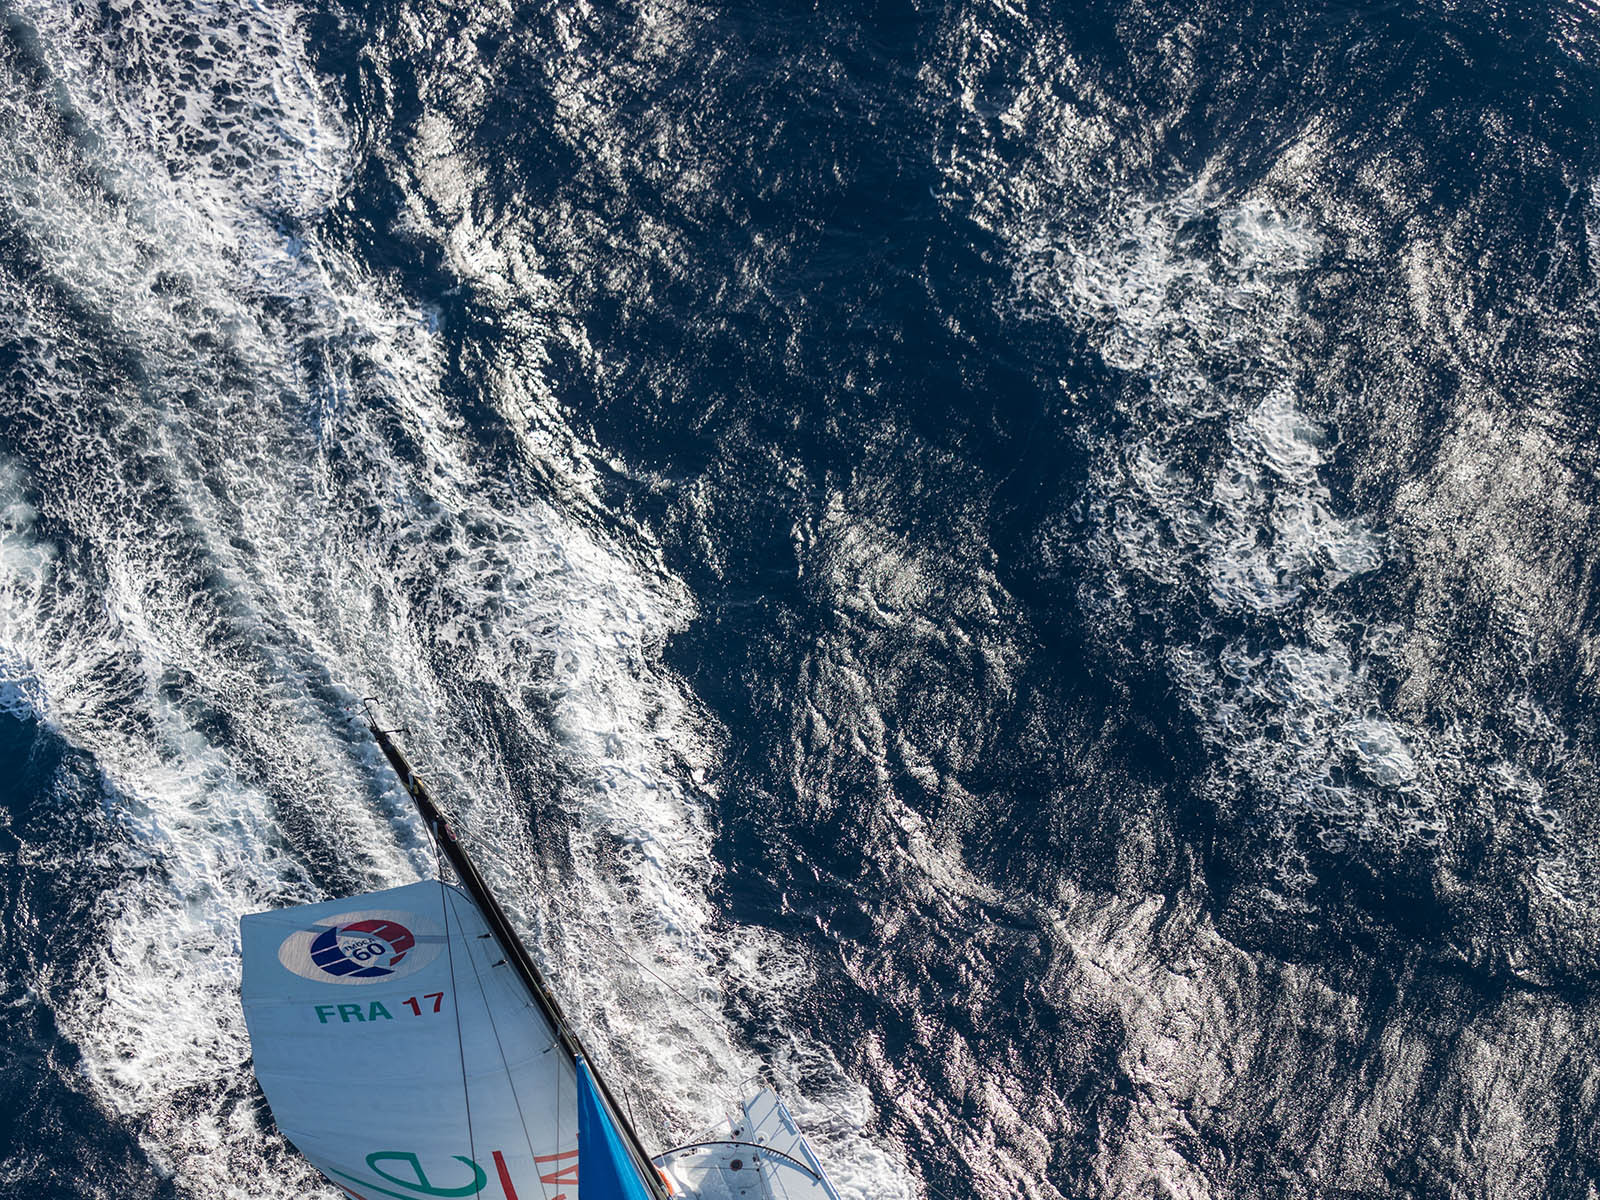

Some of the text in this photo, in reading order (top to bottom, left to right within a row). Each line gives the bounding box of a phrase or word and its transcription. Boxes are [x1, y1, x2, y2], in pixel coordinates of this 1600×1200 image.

[352, 942, 386, 962] 60
[314, 991, 445, 1024] FRA 17
